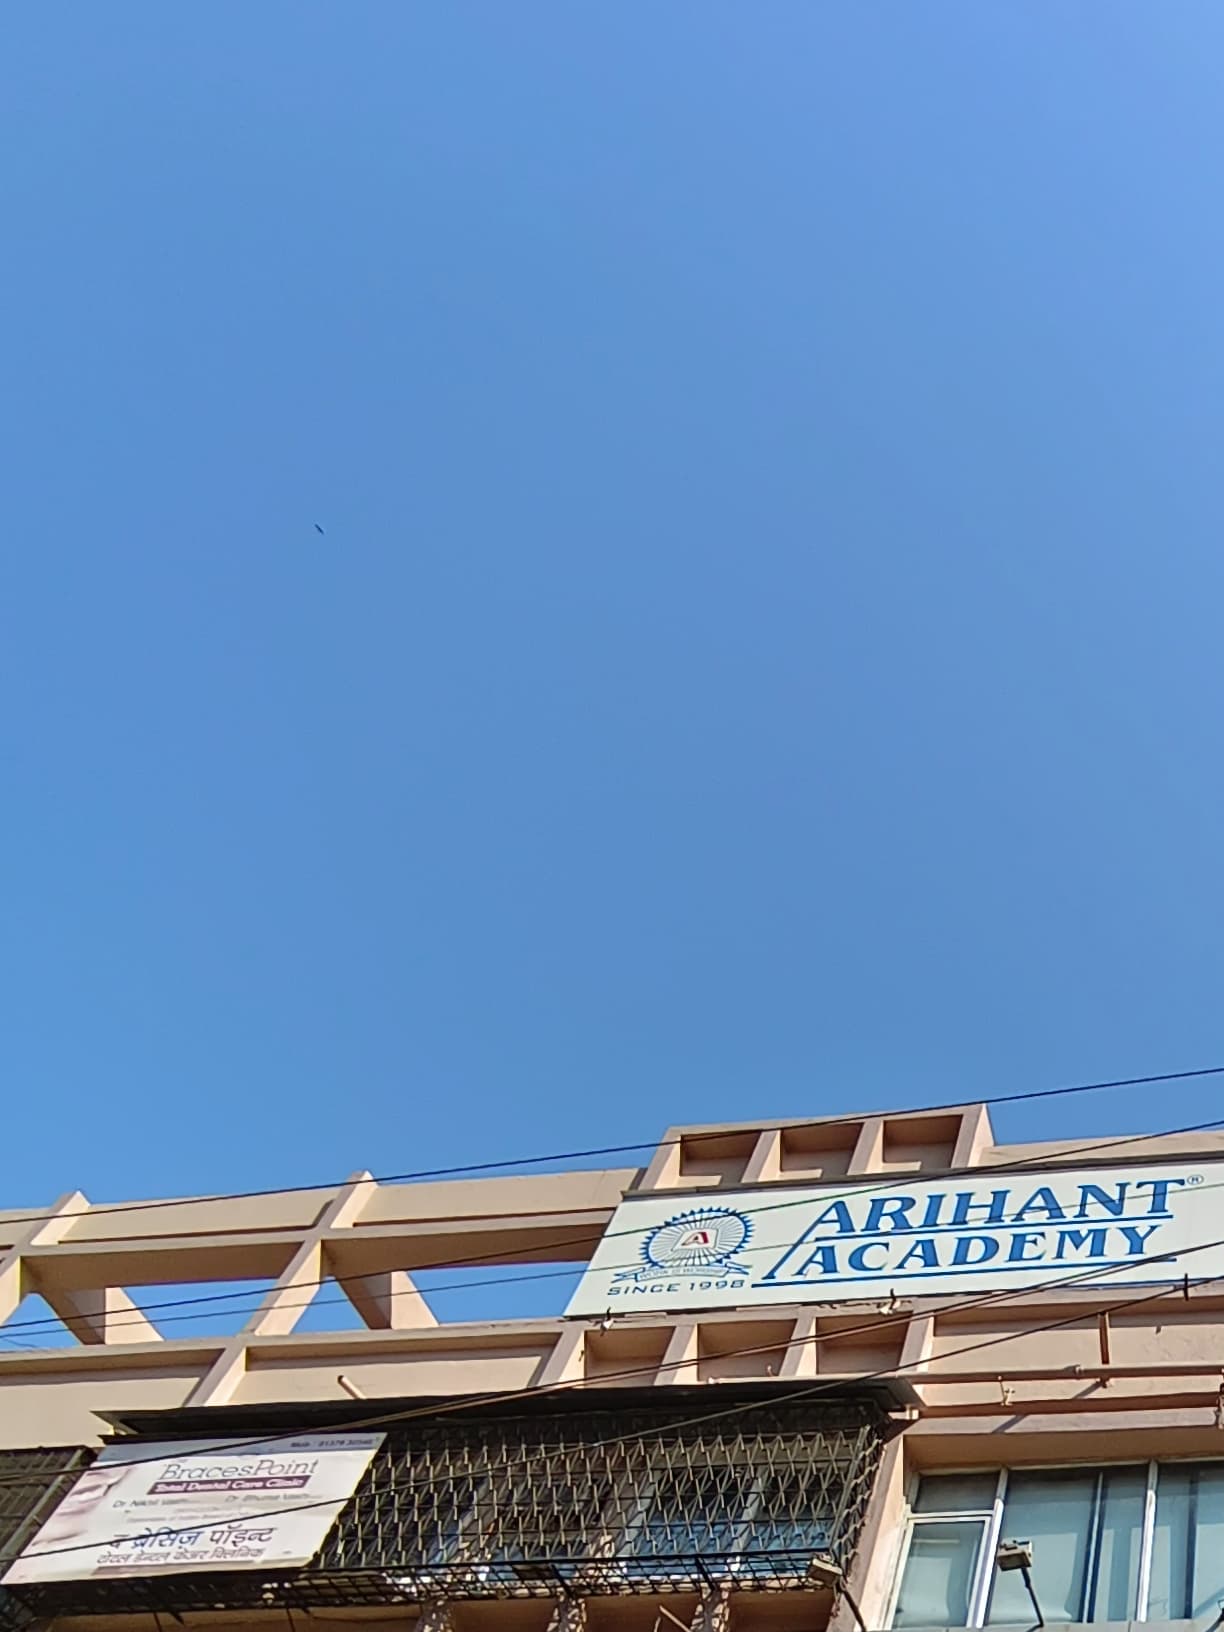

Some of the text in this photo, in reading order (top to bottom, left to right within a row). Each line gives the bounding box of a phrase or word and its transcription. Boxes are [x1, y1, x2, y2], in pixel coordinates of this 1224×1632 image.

[808, 1178, 1187, 1235] ARIHANT
[792, 1225, 1162, 1277] ACADEMY
[607, 1280, 745, 1296] SINCE 1998
